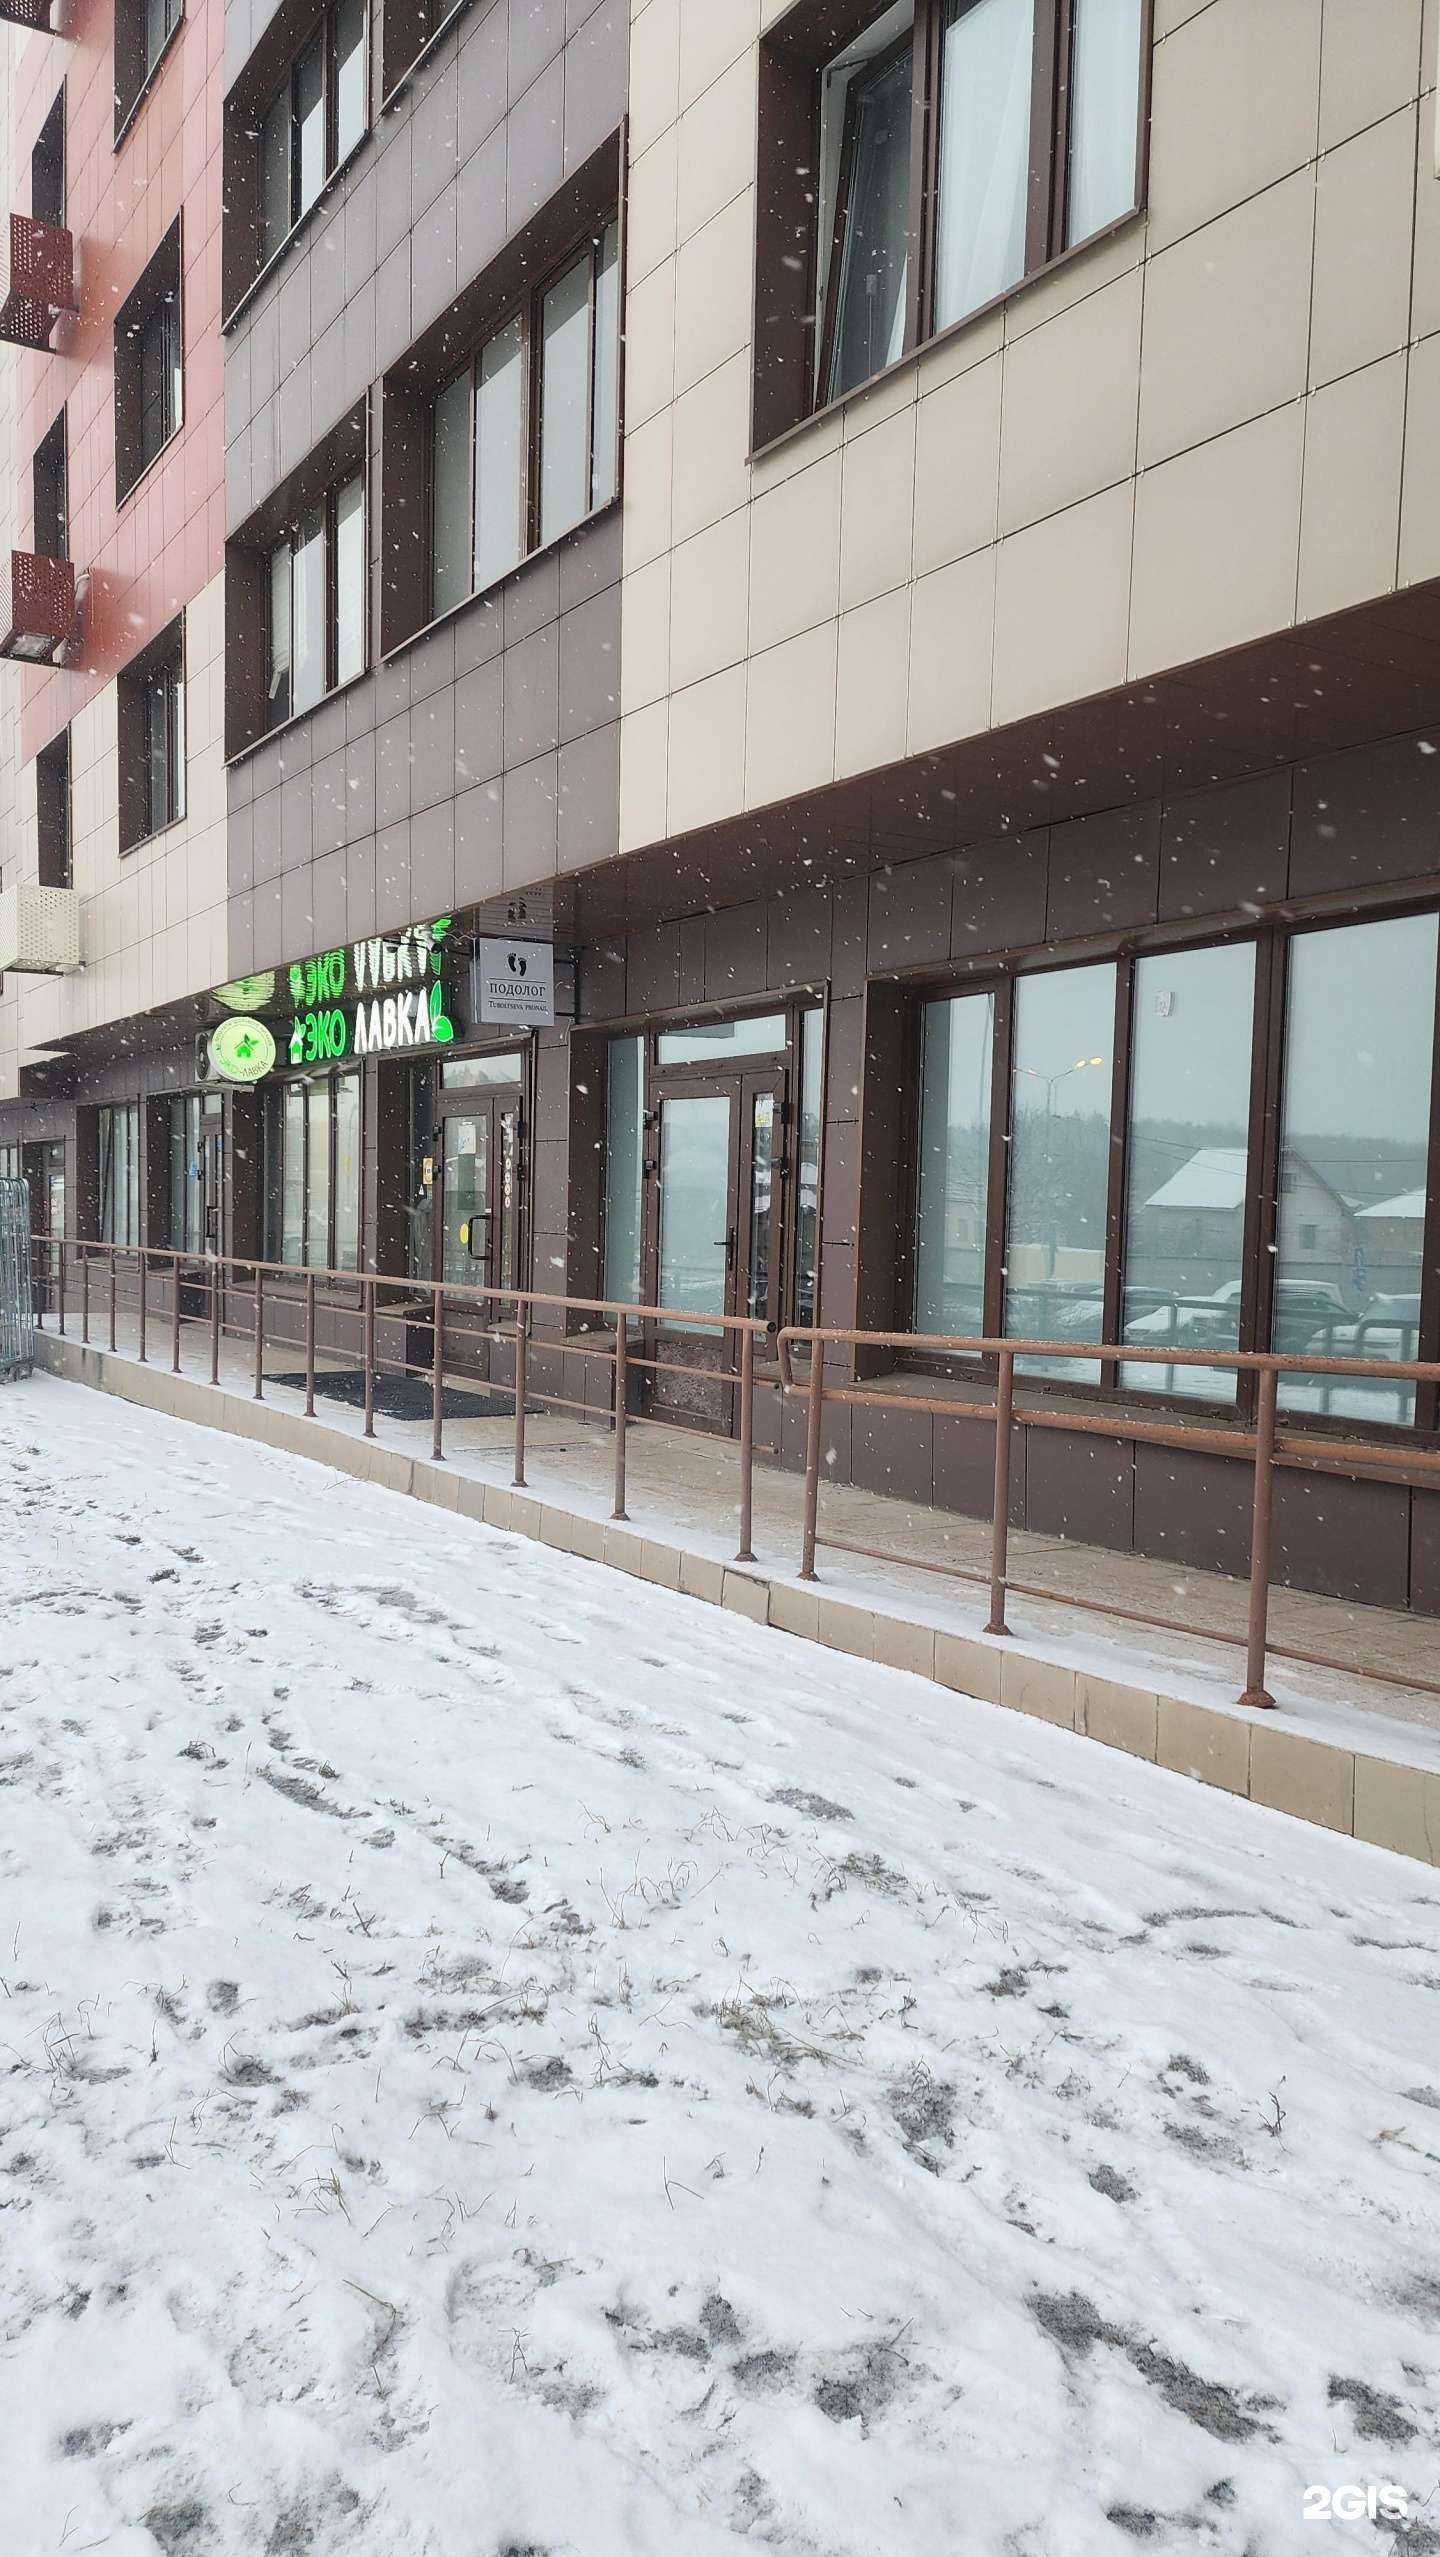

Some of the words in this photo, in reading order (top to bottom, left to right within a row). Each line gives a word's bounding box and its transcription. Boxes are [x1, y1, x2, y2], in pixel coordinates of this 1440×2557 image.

[489, 983, 546, 996] ПОДОЛОГ
[305, 1008, 346, 1061] ЭКО
[353, 987, 431, 1054] ЛАВКА
